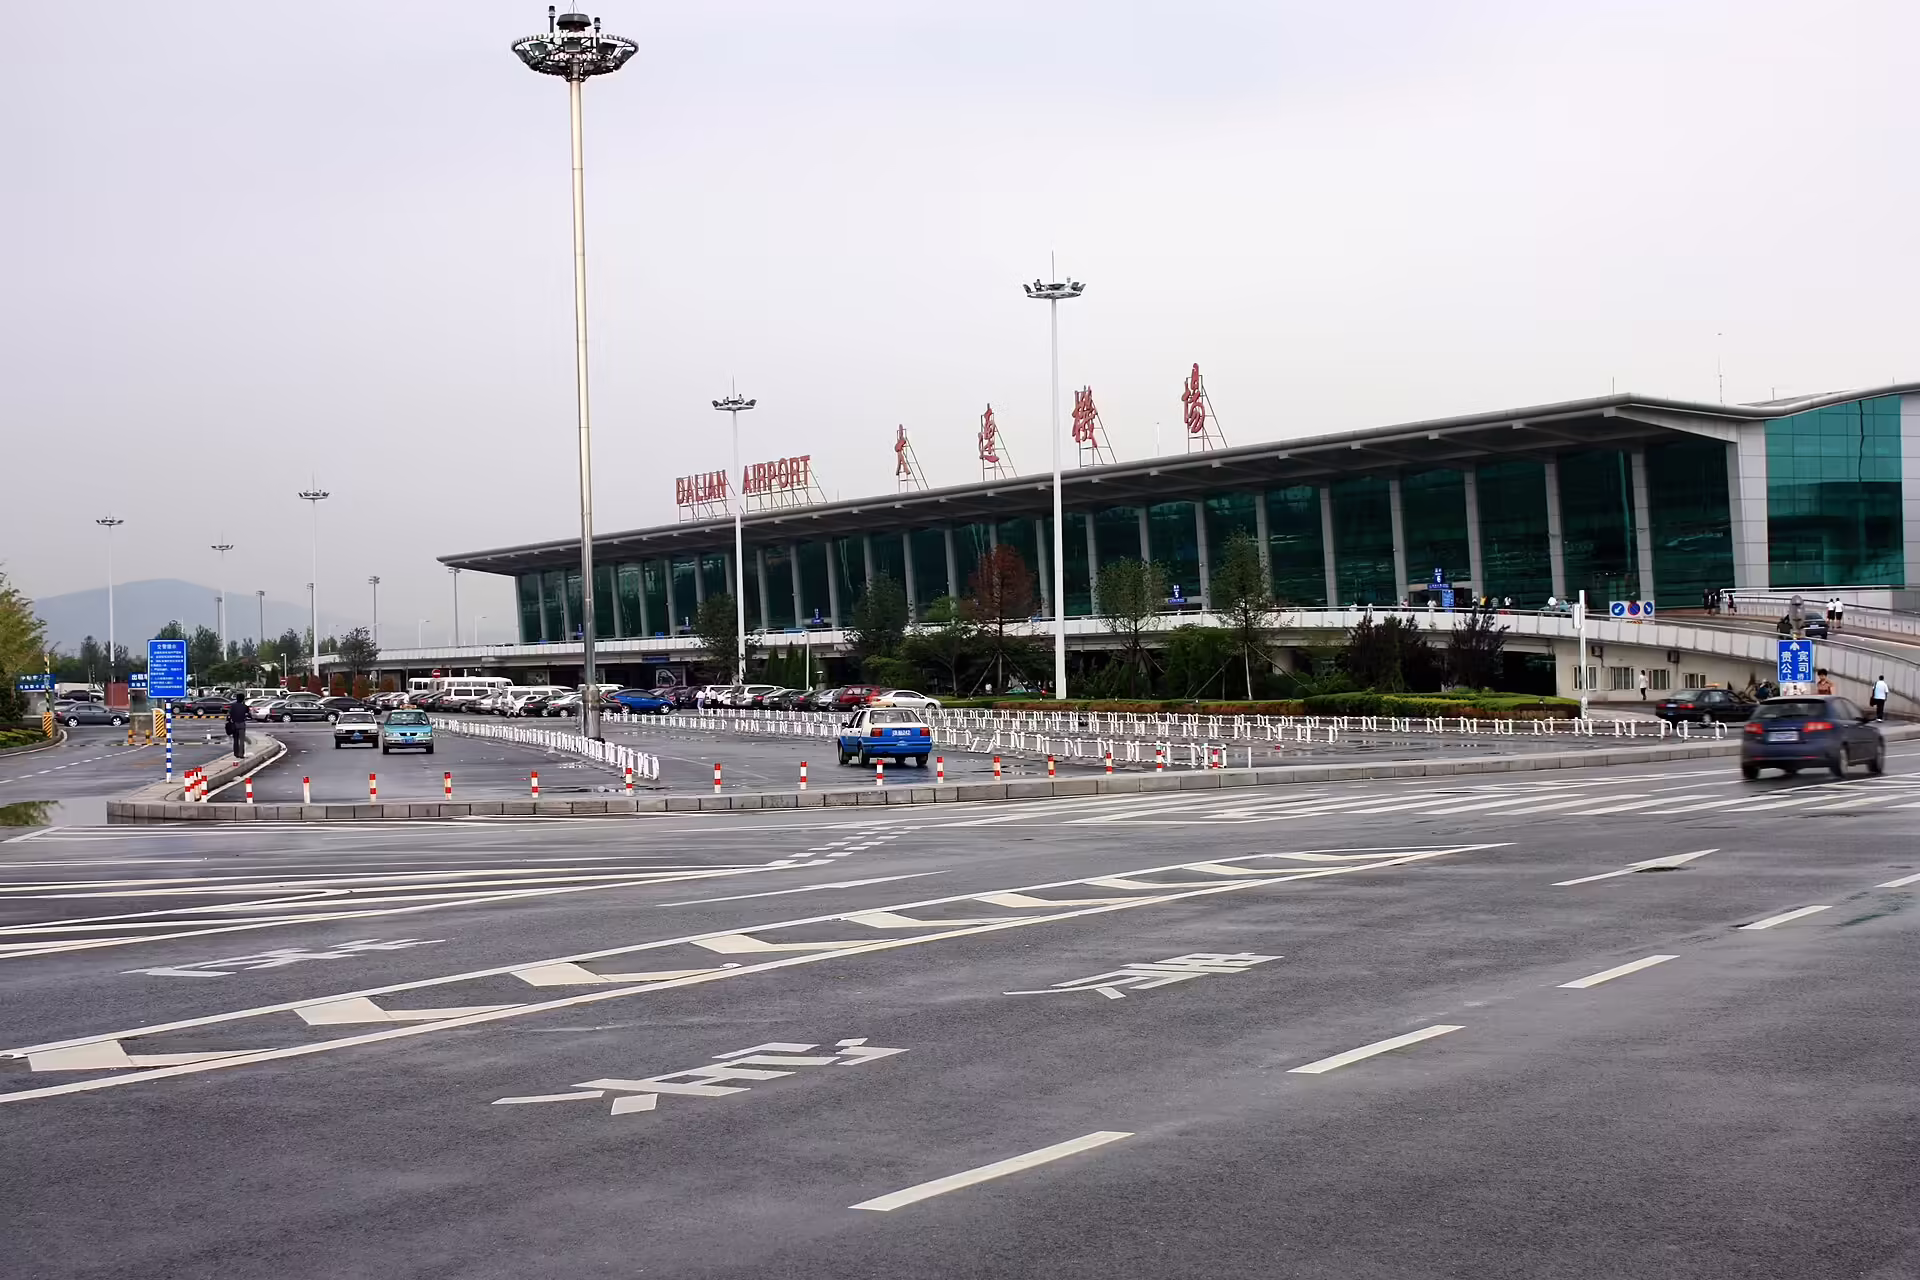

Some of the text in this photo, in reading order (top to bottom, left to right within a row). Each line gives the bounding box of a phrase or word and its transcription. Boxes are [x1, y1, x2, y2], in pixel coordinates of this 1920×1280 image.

[676, 455, 811, 504] DALIAN AIRPORT
[1780, 650, 1809, 662] 贵宾
[1780, 663, 1809, 673] 公司
